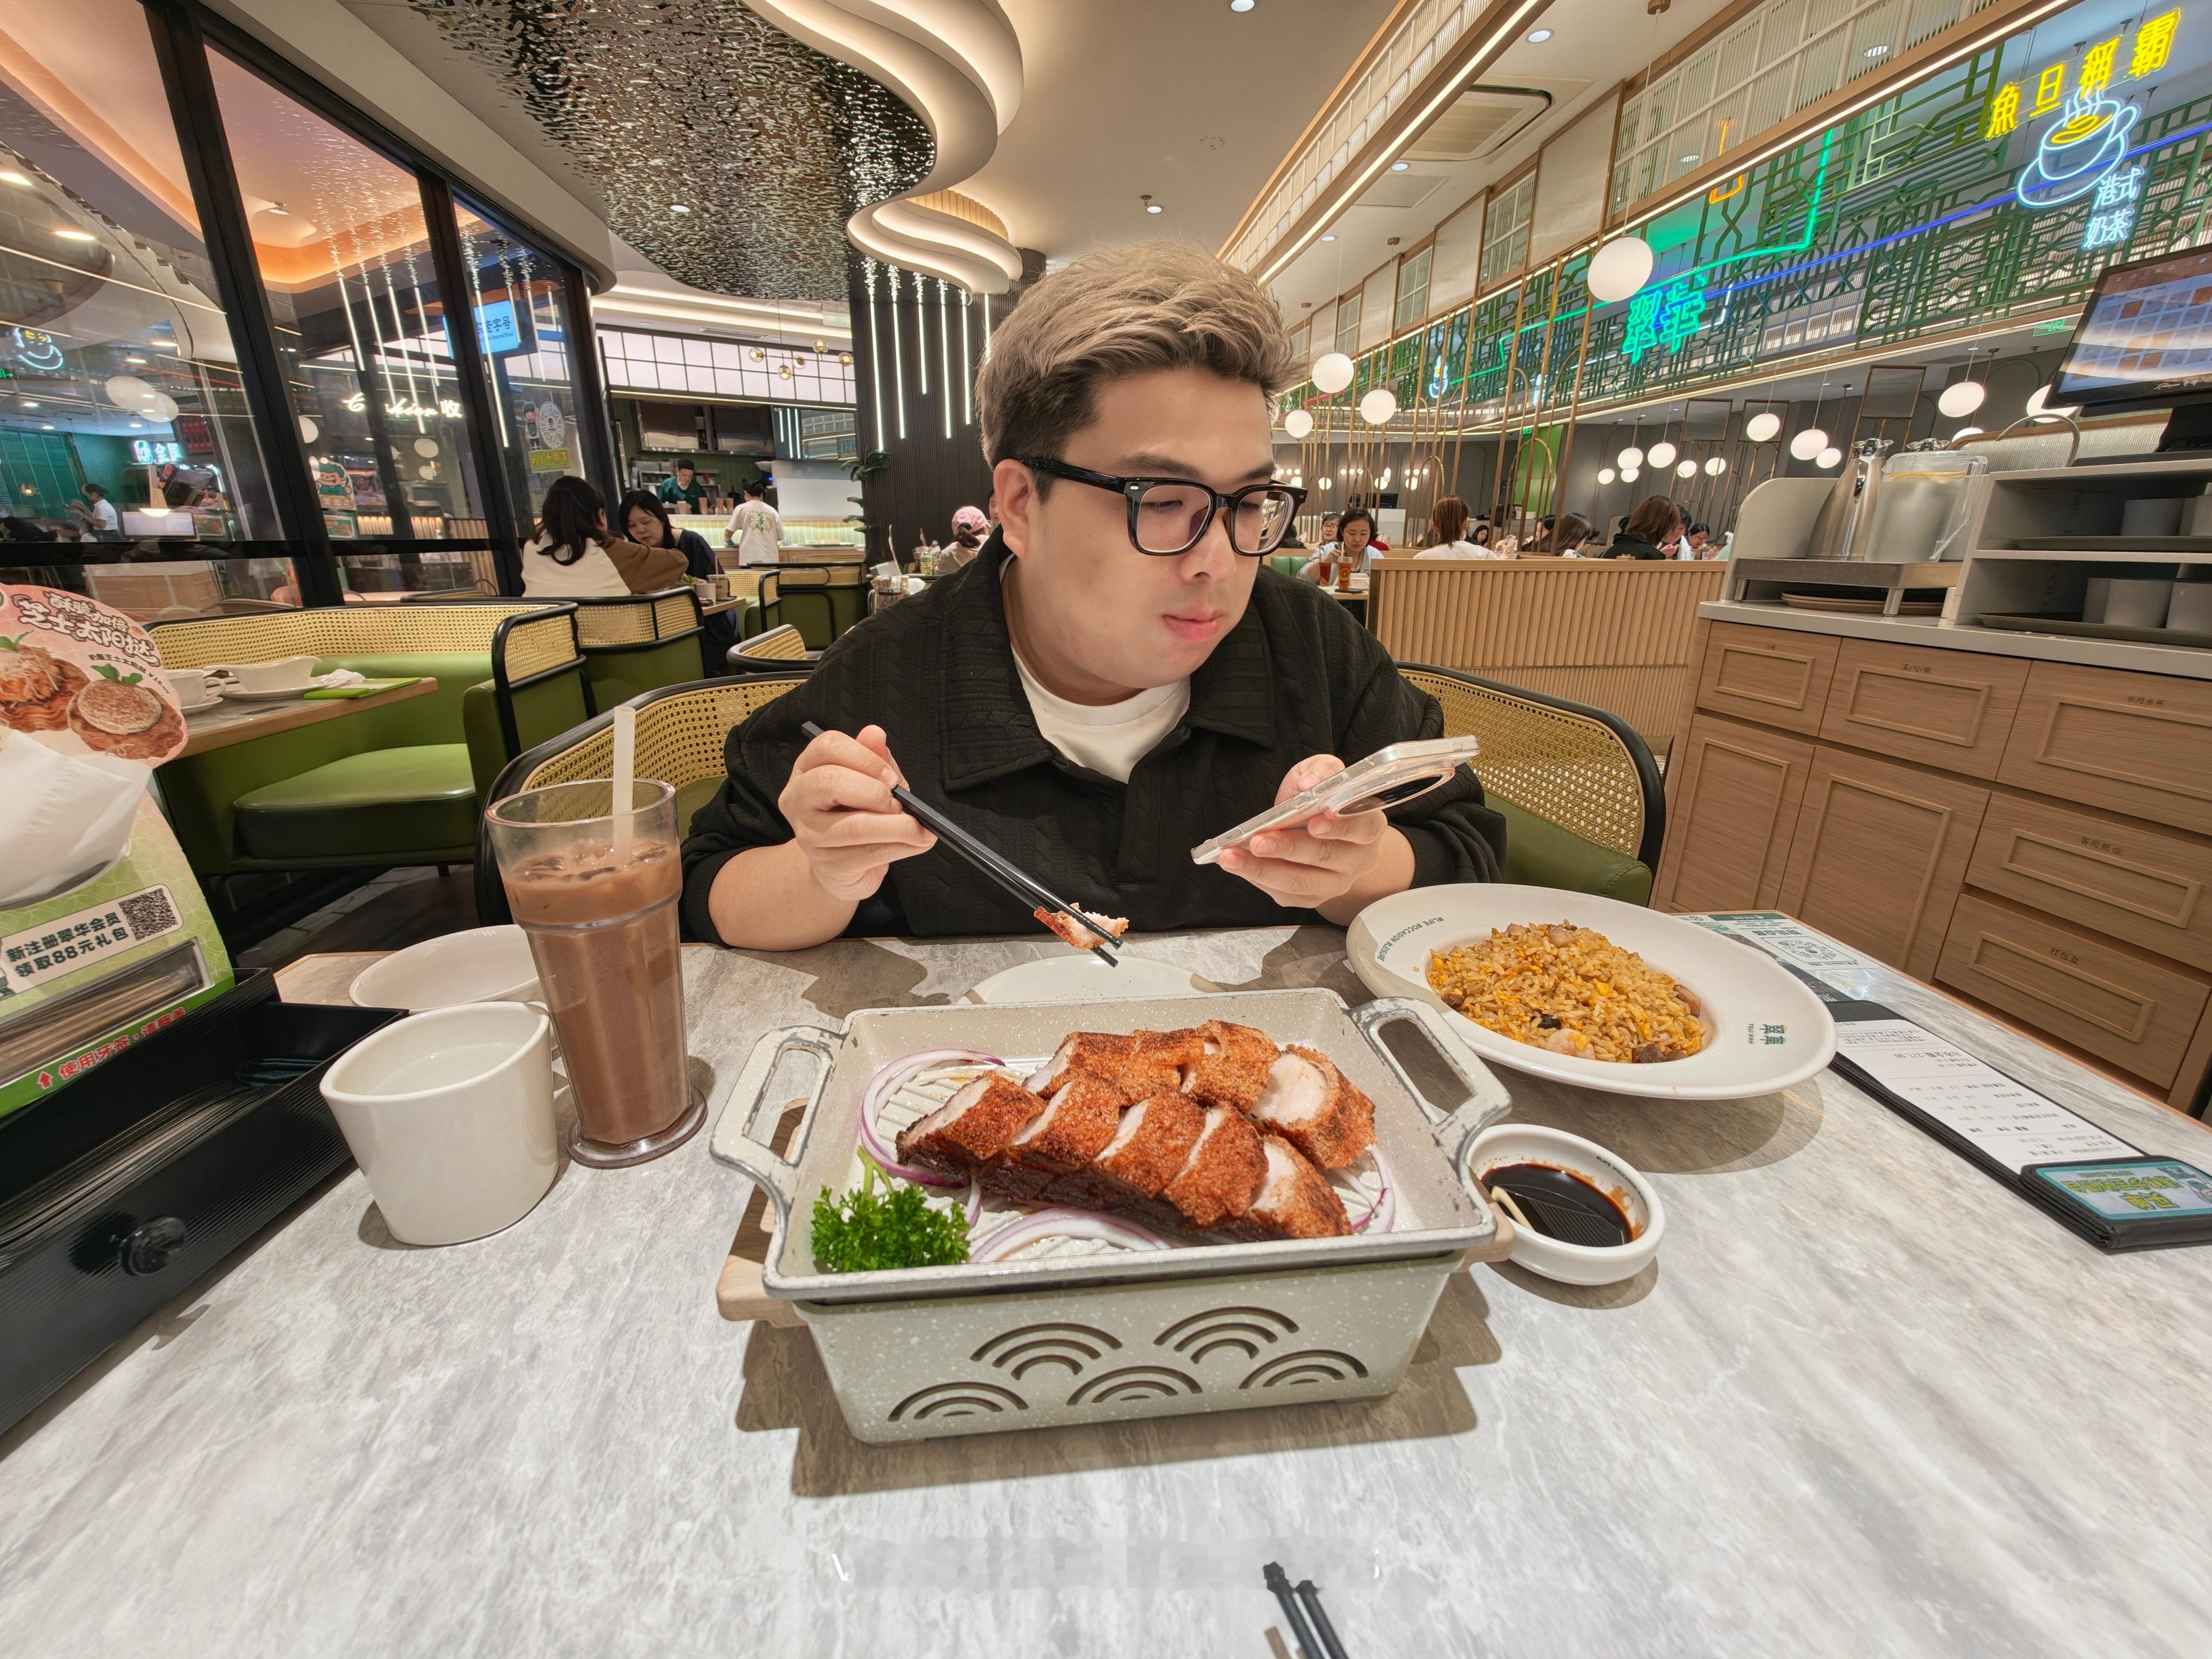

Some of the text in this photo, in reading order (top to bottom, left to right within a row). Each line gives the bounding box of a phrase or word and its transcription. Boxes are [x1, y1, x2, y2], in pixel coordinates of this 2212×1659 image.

[2092, 167, 2142, 210] 港式
[2082, 208, 2132, 249] 奶茶
[49, 593, 130, 632] 酥脆加倍
[6, 912, 122, 963] 新注册翠华会员
[15, 927, 129, 978] 领取88元礼包
[1377, 916, 1444, 962] #LIFE #OCCASION #LEISURE
